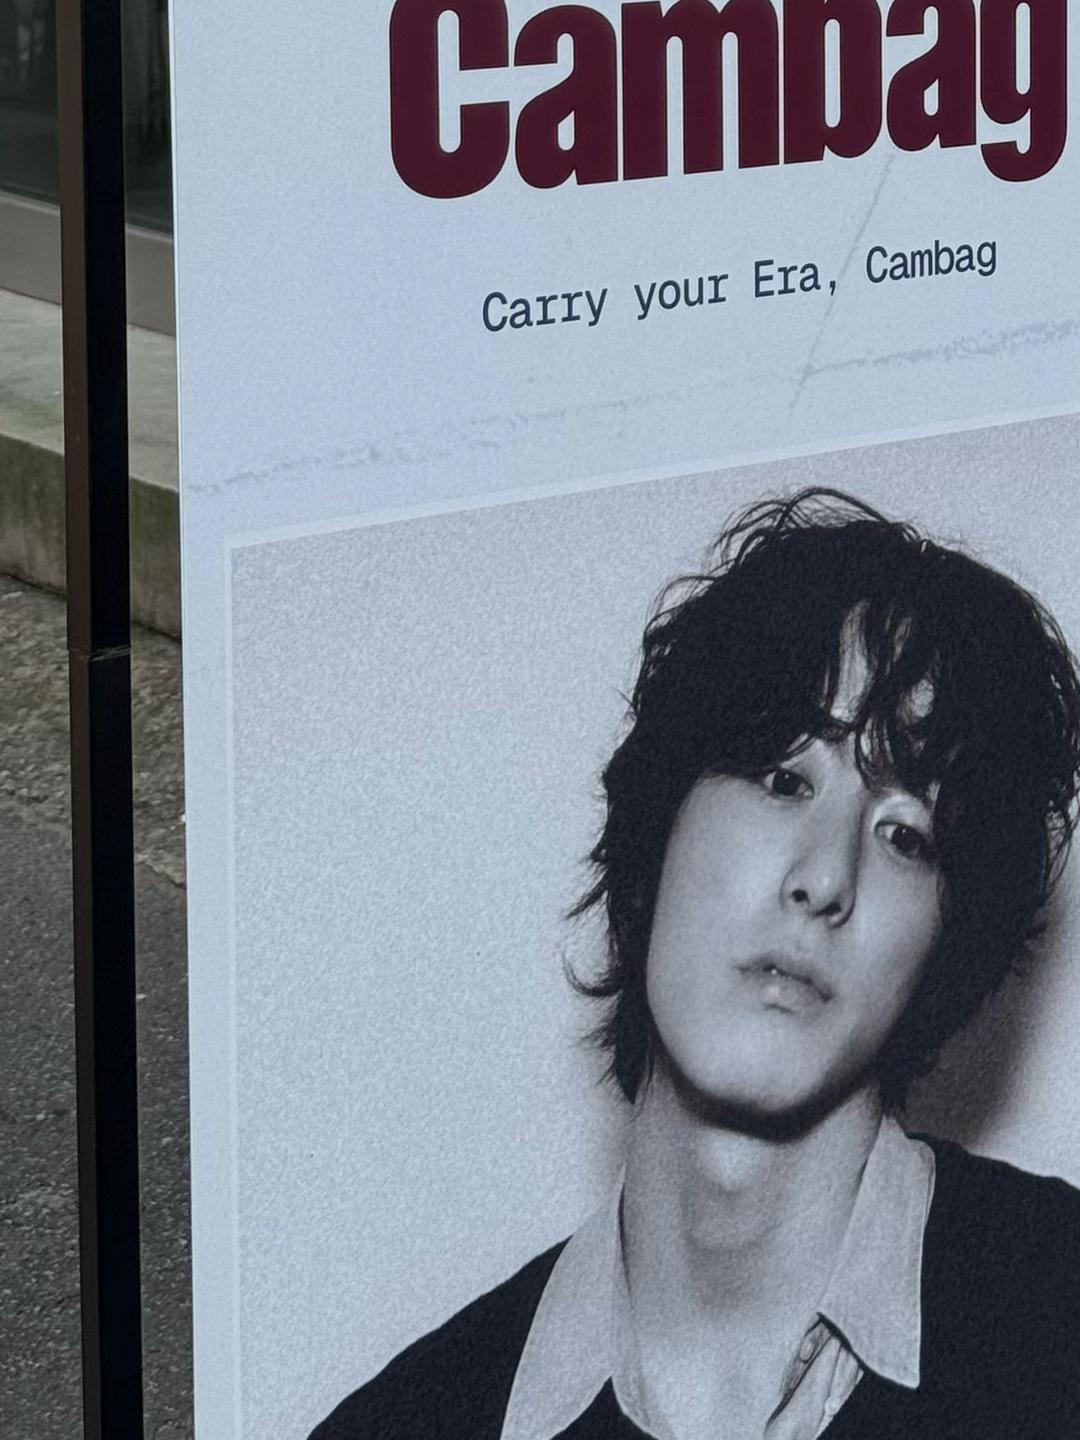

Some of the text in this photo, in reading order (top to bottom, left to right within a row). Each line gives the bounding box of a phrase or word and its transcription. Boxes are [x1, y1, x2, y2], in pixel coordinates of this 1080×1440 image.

[482, 238, 998, 333] Carry your Era, Cambag
